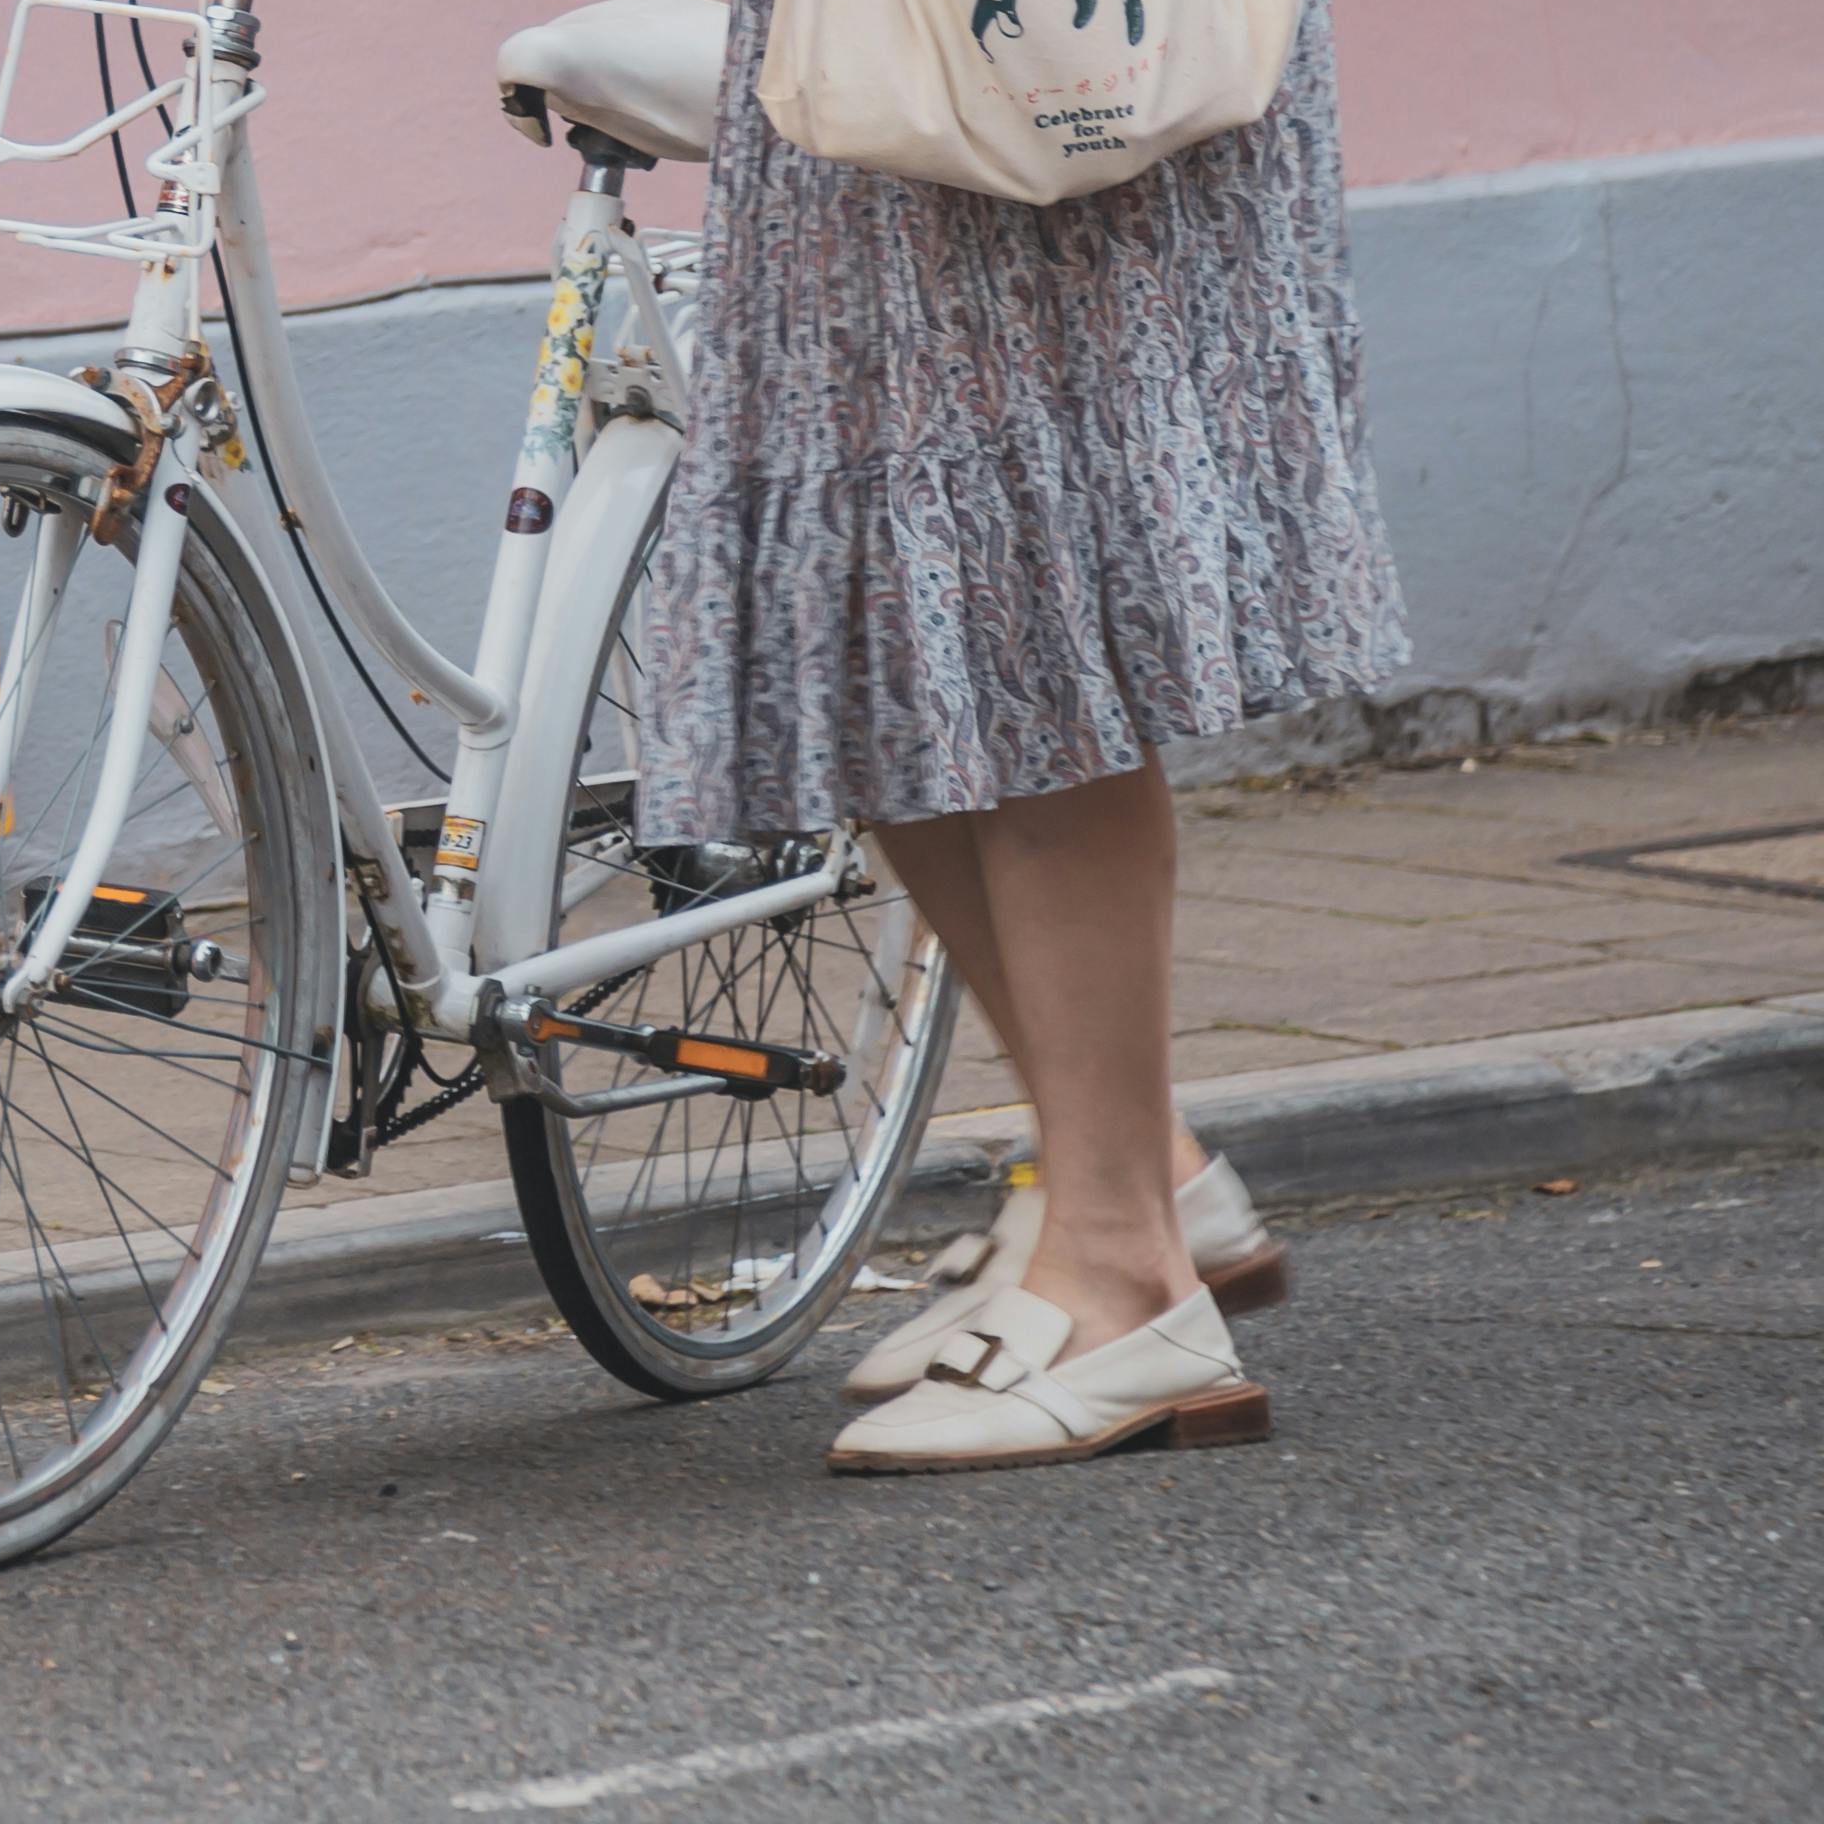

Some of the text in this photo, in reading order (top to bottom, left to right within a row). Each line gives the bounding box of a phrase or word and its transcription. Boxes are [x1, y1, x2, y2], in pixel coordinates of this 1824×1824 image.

[1035, 104, 1135, 128] Celebrate
[1074, 124, 1104, 137] for
[1063, 137, 1126, 158] youth
